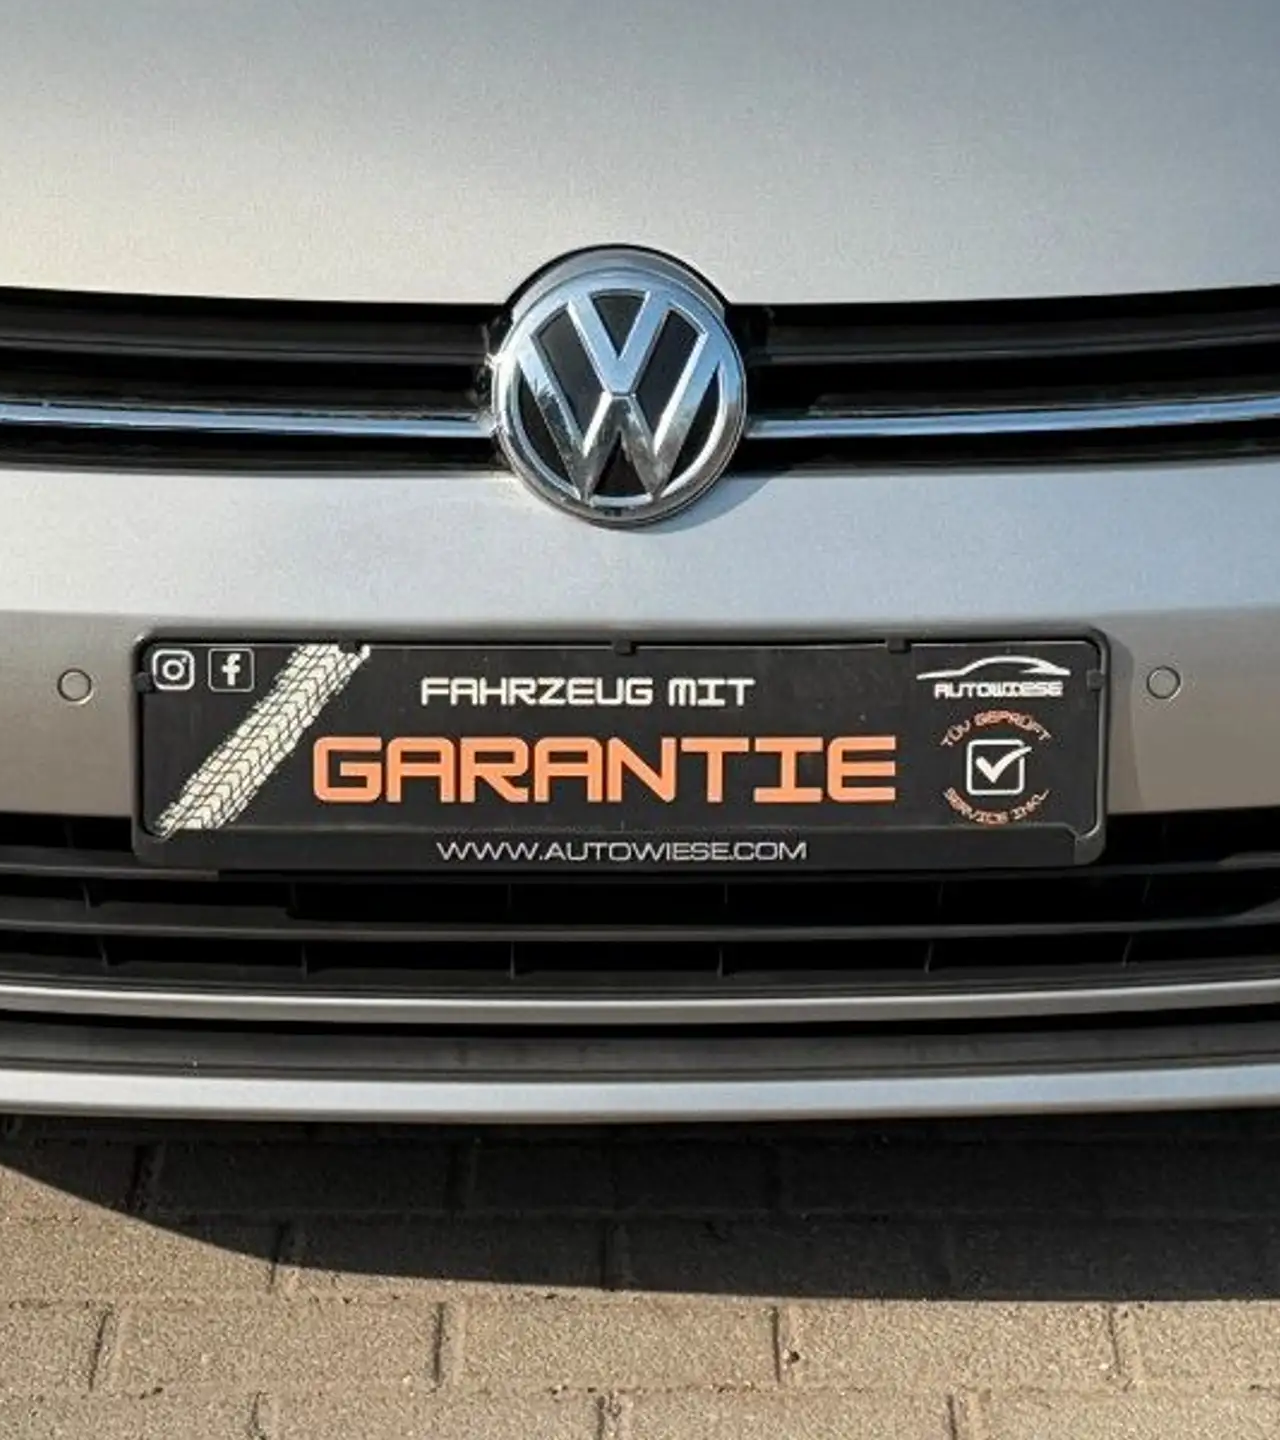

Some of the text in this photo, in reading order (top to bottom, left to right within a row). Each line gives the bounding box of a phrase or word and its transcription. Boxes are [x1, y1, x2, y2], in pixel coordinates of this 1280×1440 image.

[420, 677, 755, 707] FAHRZEUG MIT
[933, 680, 1064, 700] AUTOWIESE
[312, 735, 897, 804] GARANTIE
[436, 840, 808, 862] WWW.AUTOWIESE.COM
